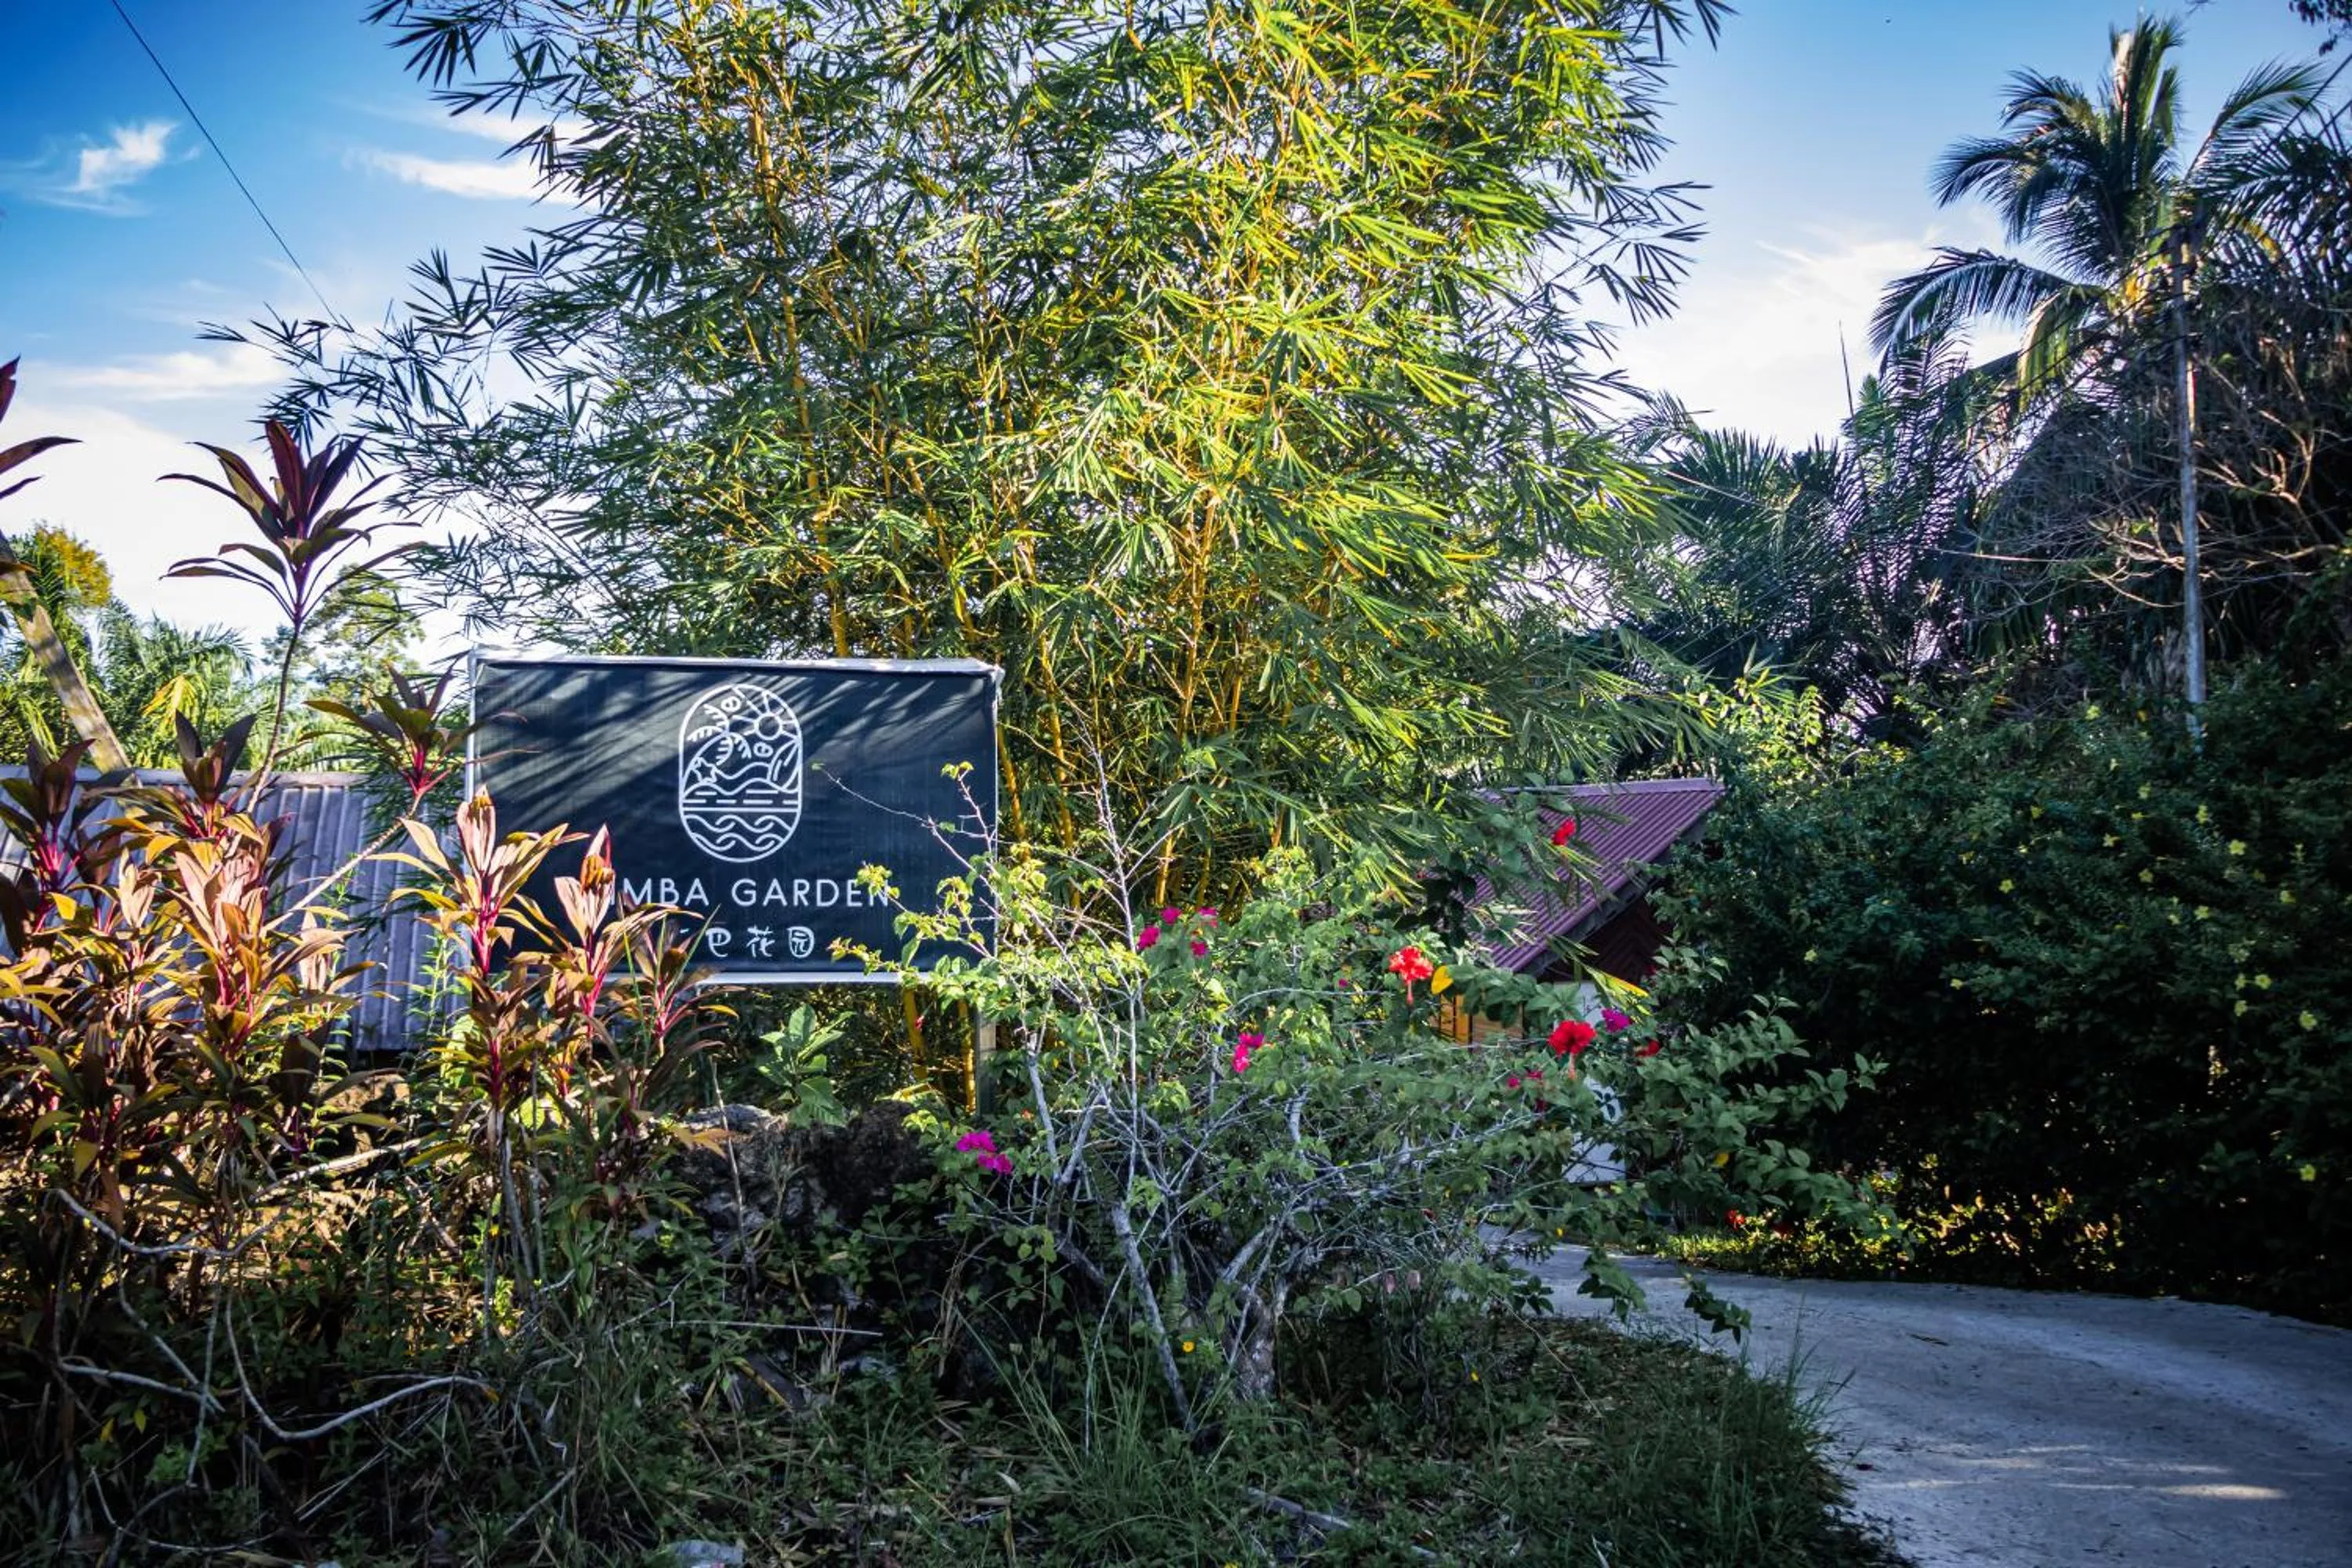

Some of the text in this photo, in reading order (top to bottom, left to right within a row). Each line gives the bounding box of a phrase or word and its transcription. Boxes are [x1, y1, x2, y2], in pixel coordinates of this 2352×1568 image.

[731, 877, 888, 907] GARDEN
[680, 925, 815, 959] 巴花园
